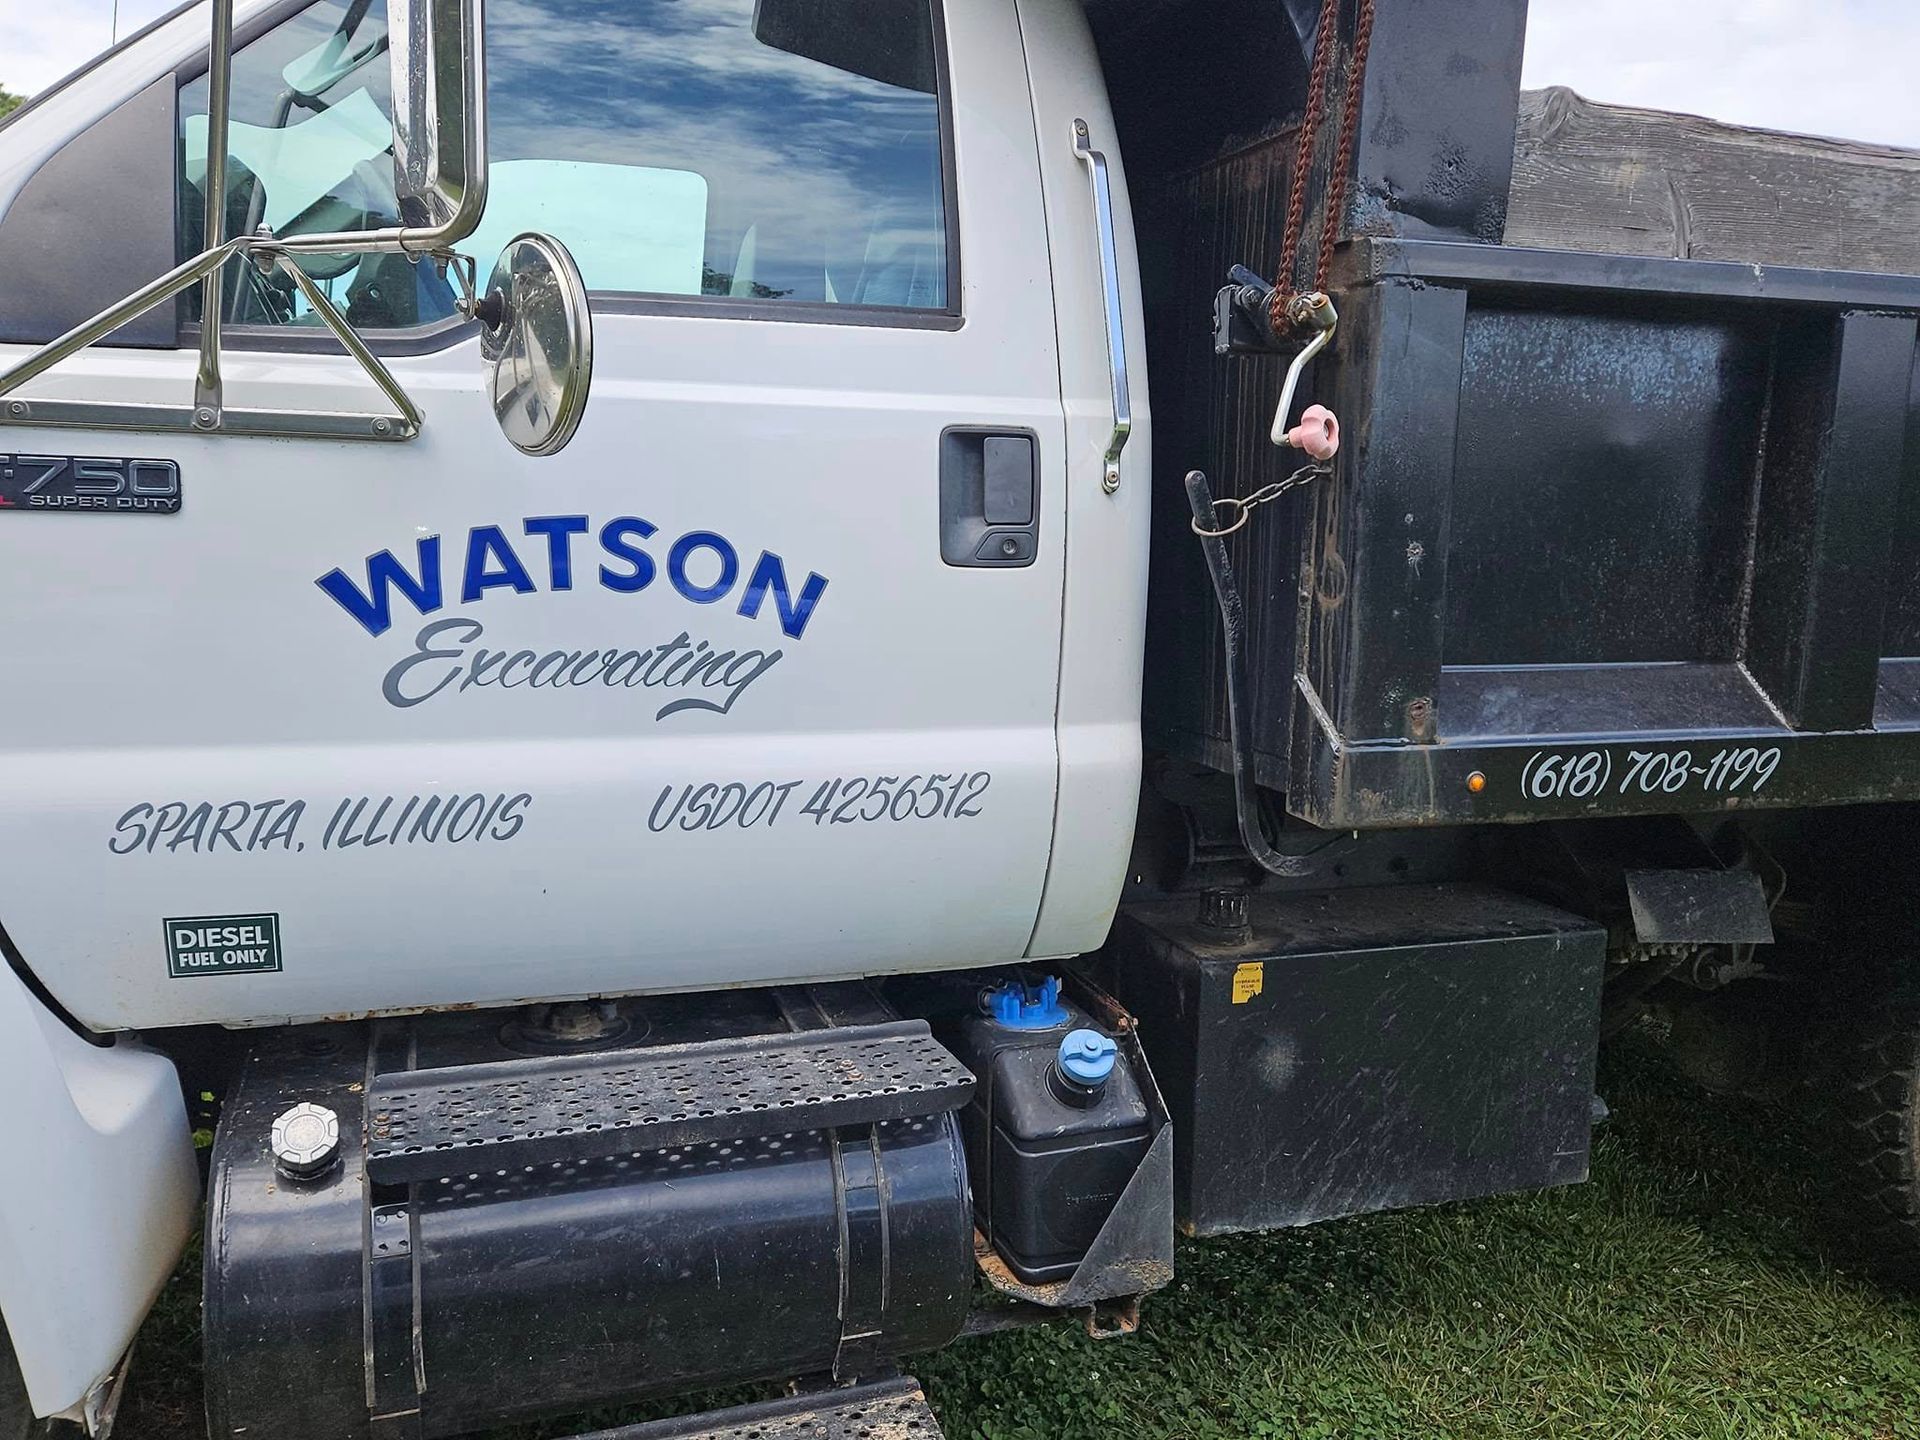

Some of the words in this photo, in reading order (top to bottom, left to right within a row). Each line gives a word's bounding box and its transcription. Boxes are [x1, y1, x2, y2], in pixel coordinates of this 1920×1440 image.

[0, 455, 178, 496] -750
[30, 495, 108, 508] SUPER
[117, 497, 177, 509] DUTY
[314, 515, 829, 640] WATSON
[382, 618, 783, 721] Excavating
[1521, 750, 1611, 799] (618)
[1619, 748, 1781, 794] 708-1199
[322, 793, 533, 850] ILLINOIS
[648, 780, 804, 832] USDOT
[799, 771, 991, 826] 4256512
[175, 925, 270, 949] DIESEL
[178, 951, 220, 968] FUEL
[222, 948, 268, 965] ONLY
